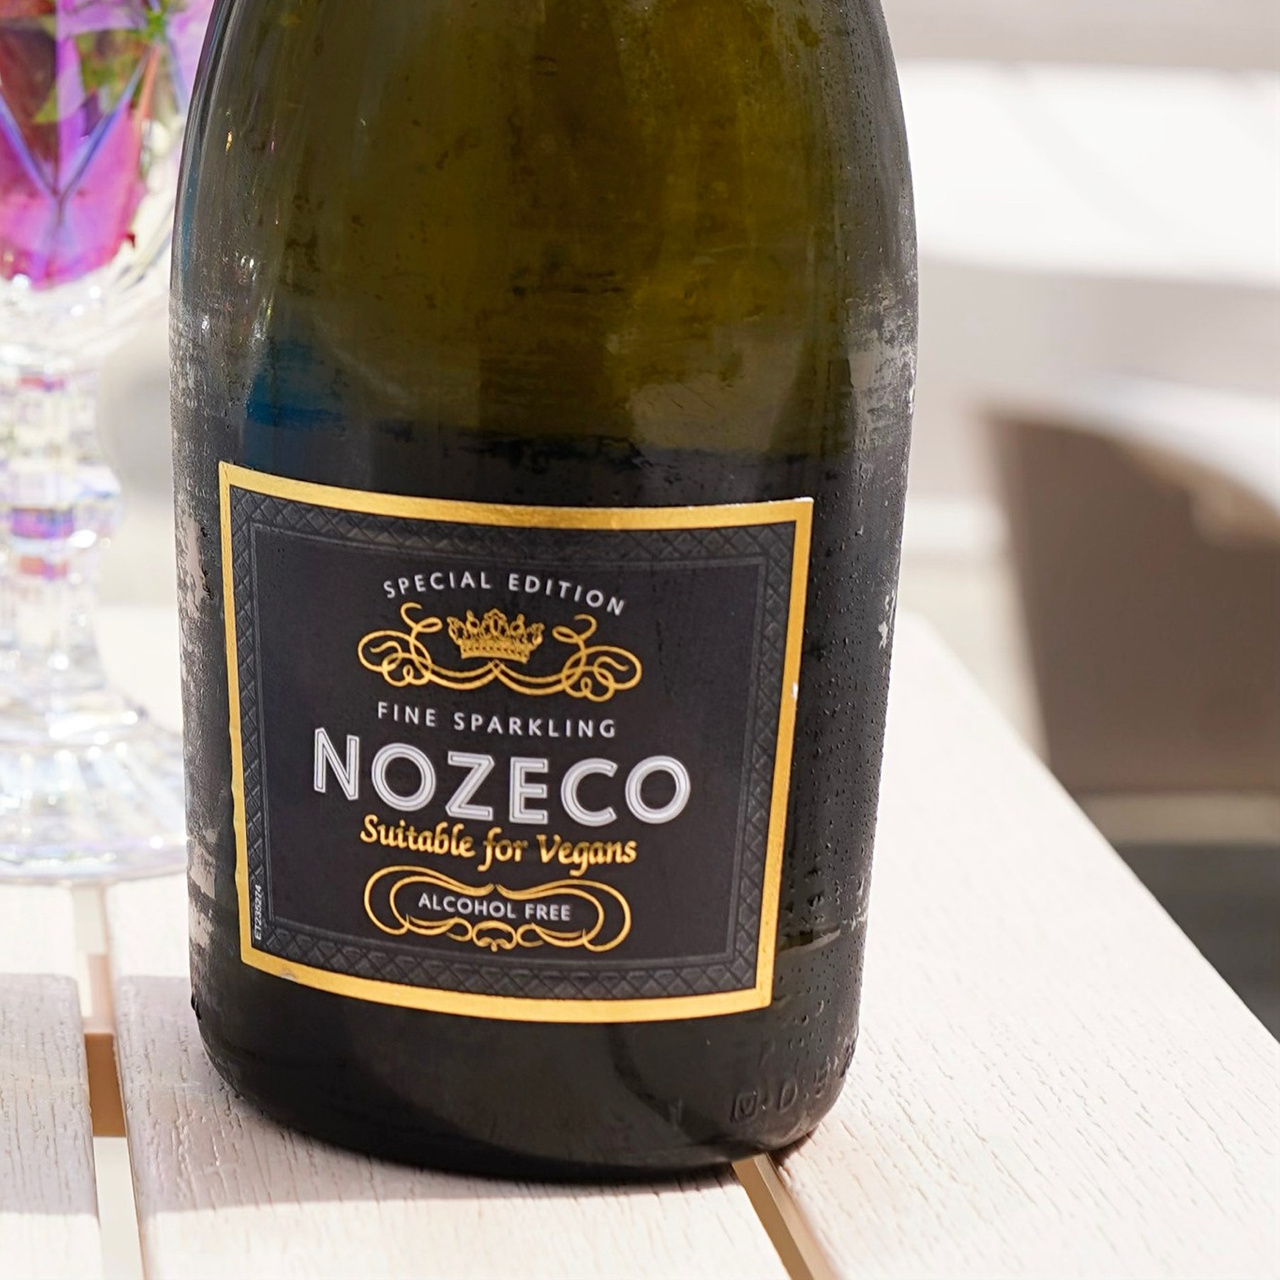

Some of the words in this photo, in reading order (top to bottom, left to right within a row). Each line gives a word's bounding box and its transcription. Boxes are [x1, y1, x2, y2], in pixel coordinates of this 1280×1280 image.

[383, 571, 491, 598] SPECIAL
[508, 573, 626, 615] EDITION
[378, 702, 437, 728] FINE
[454, 712, 617, 739] SPARKLING
[313, 727, 691, 827] NOZECO
[360, 814, 476, 860] Suitable
[478, 827, 532, 872] for
[536, 833, 638, 877] Vegans
[253, 885, 266, 941] ET235274
[418, 893, 517, 920] ALCOHOL
[525, 902, 572, 922] FREE
